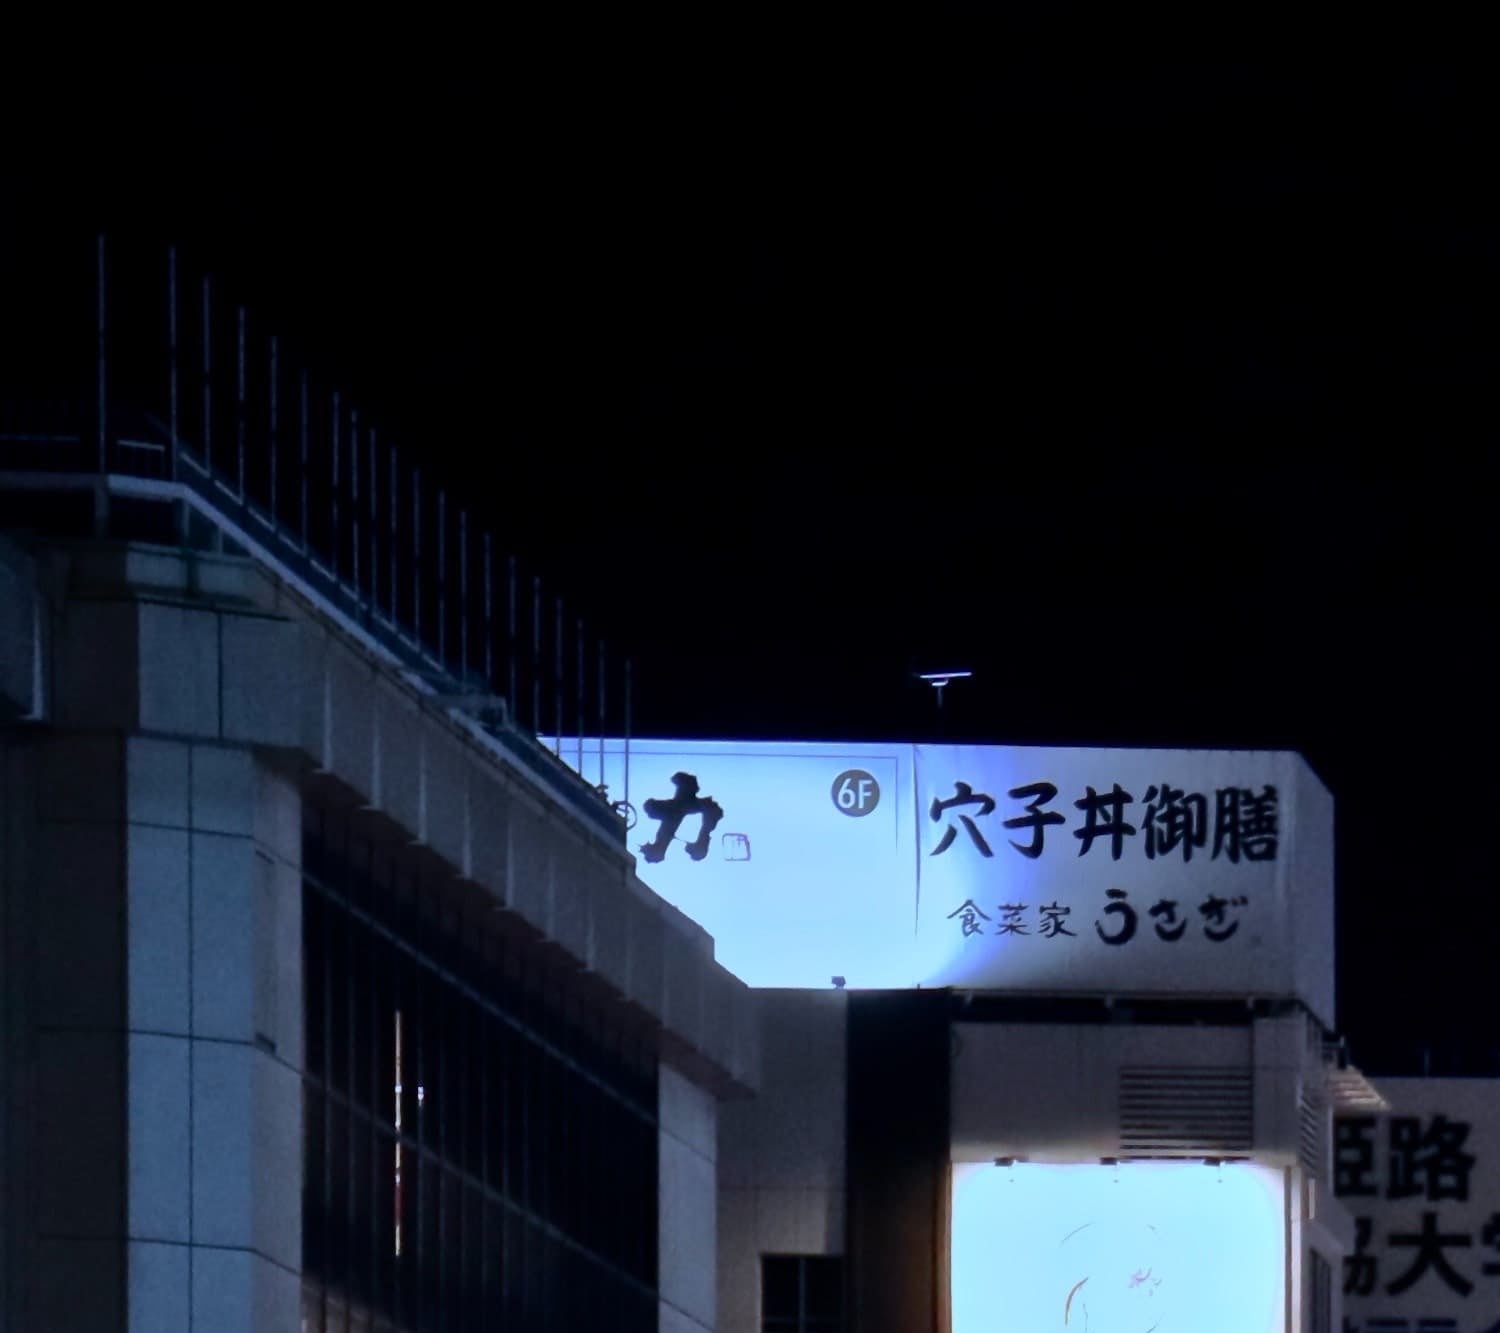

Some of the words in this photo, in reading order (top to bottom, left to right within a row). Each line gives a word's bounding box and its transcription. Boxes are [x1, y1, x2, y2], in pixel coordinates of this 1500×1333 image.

[837, 779, 875, 810] 6F
[929, 781, 1279, 863] 穴子丼御膳
[947, 898, 1078, 938] 食菜家
[1095, 888, 1248, 945] うさぎ
